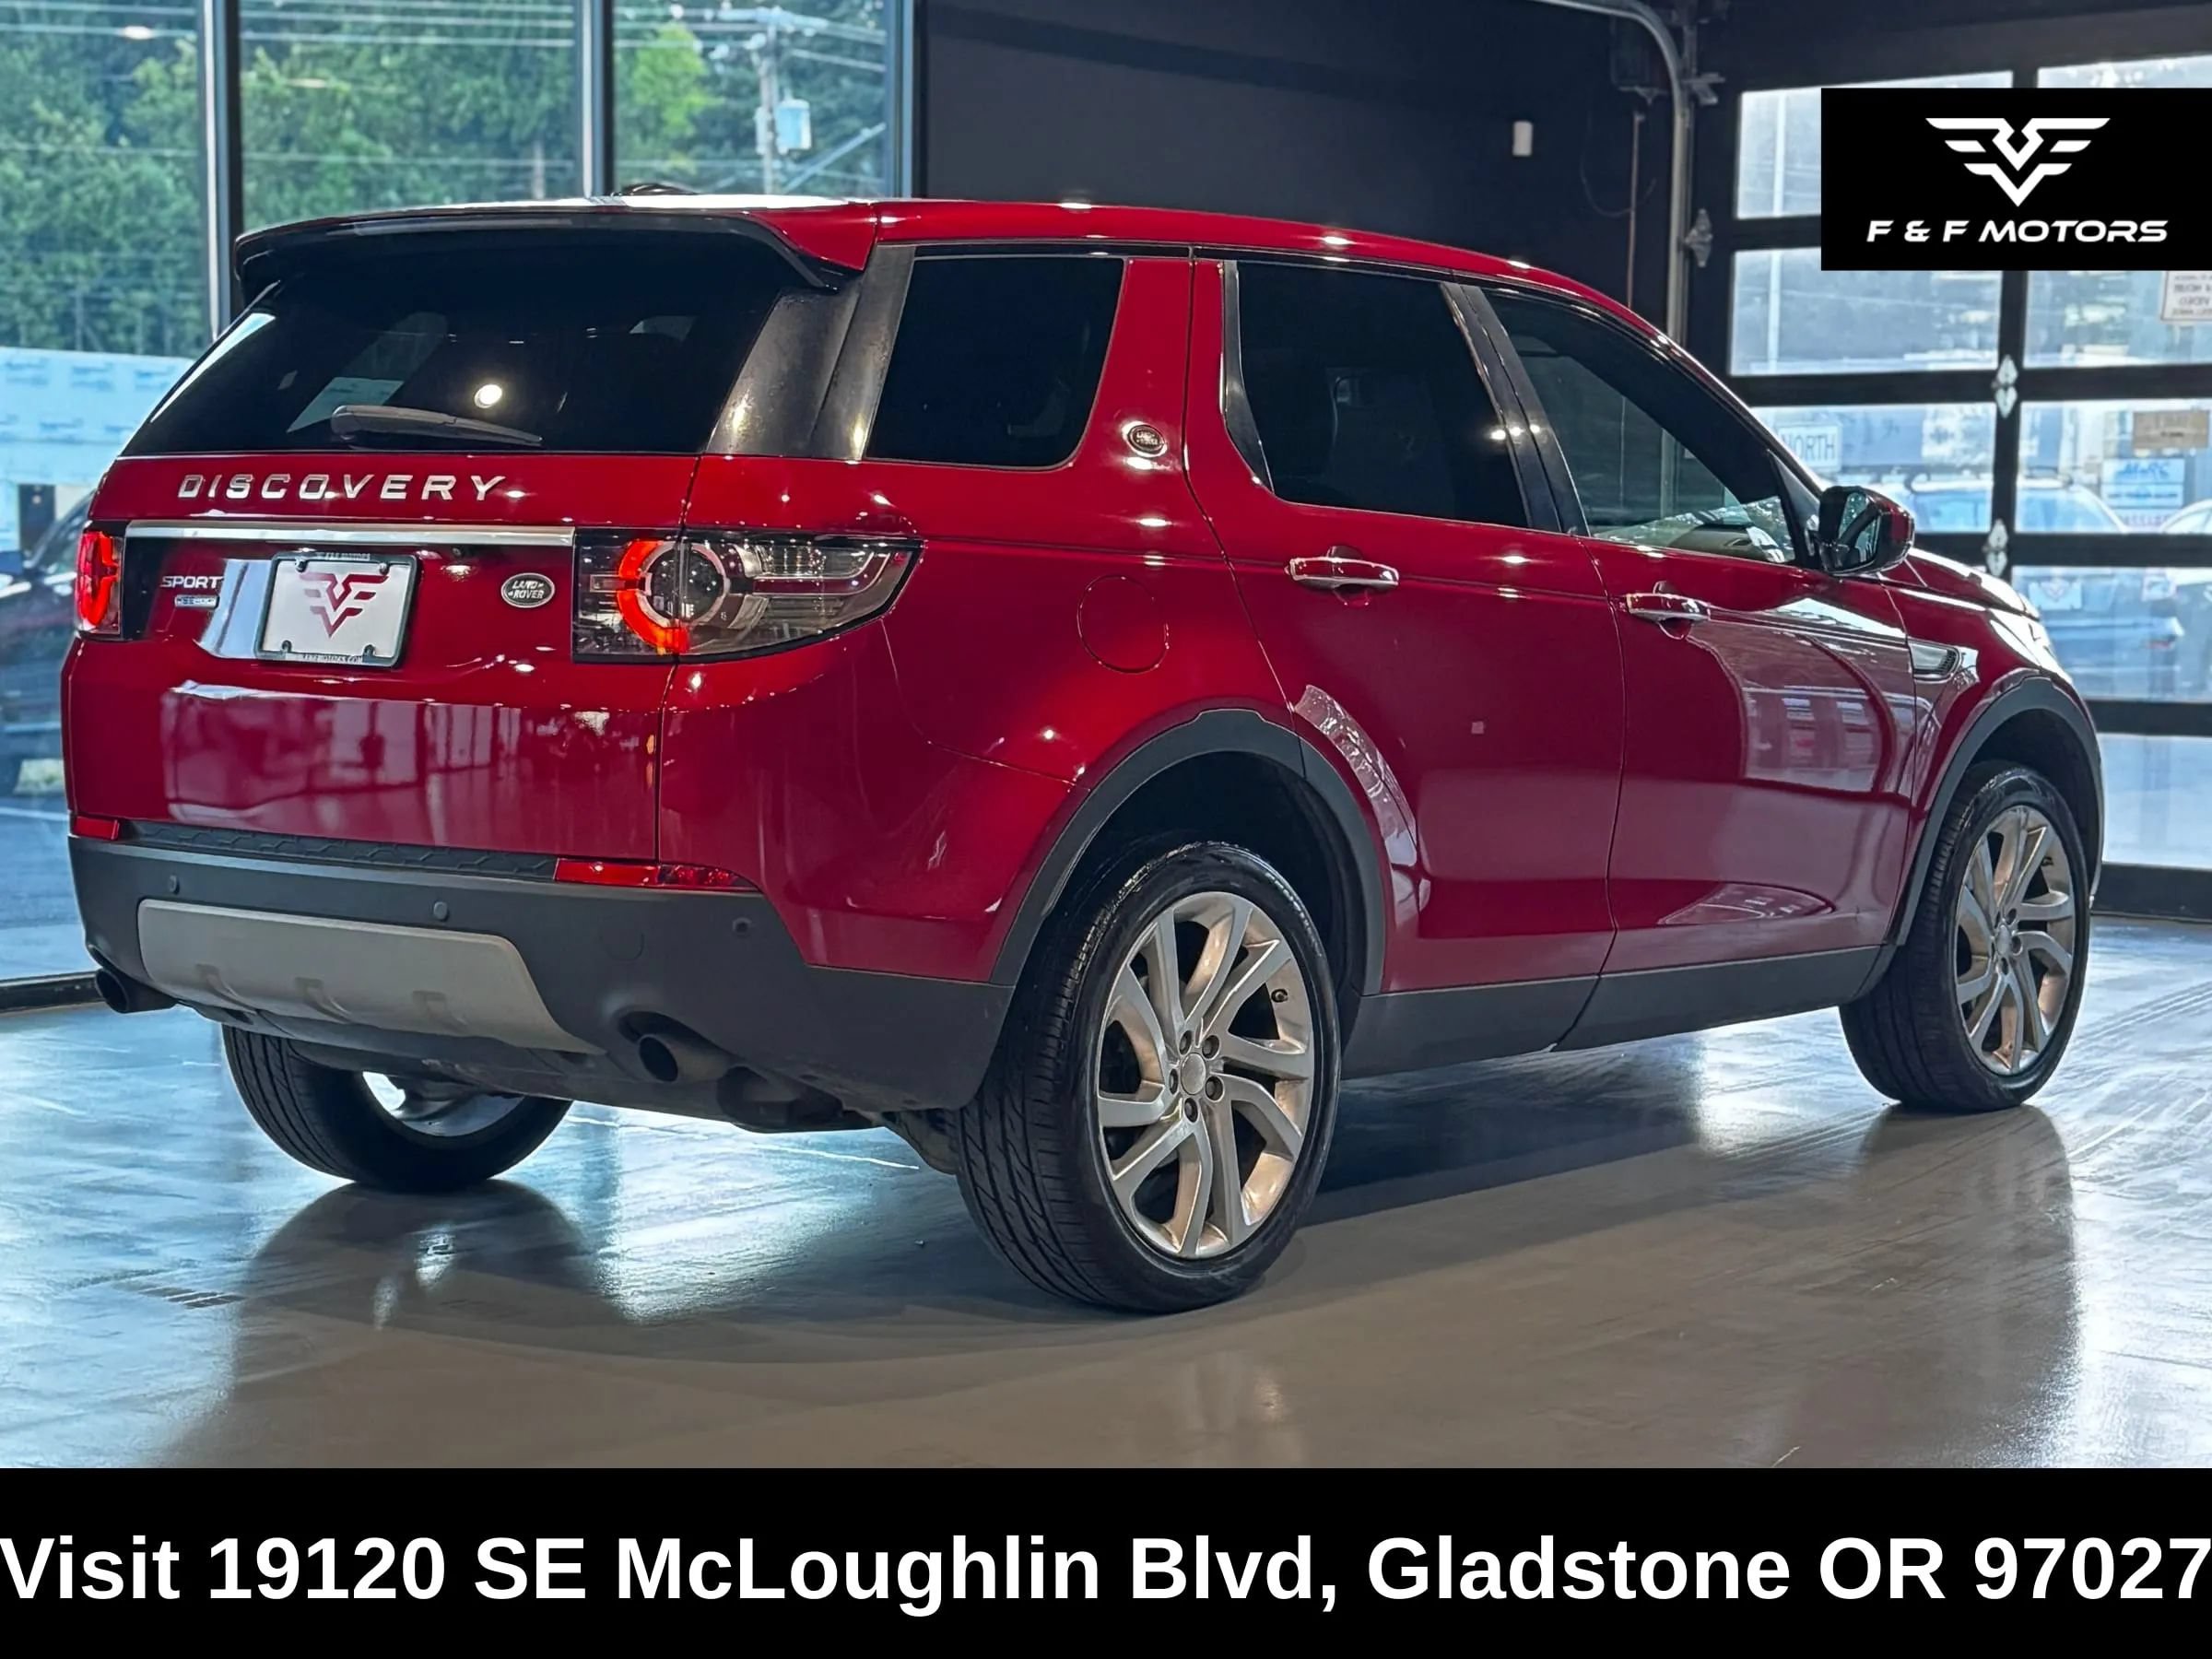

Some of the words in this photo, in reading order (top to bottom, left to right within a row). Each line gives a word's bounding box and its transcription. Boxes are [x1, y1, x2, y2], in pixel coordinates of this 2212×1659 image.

[178, 473, 506, 501] DISCOVERY
[160, 575, 224, 589] SPORT
[512, 580, 538, 589] LAND
[512, 589, 545, 599] ROVER
